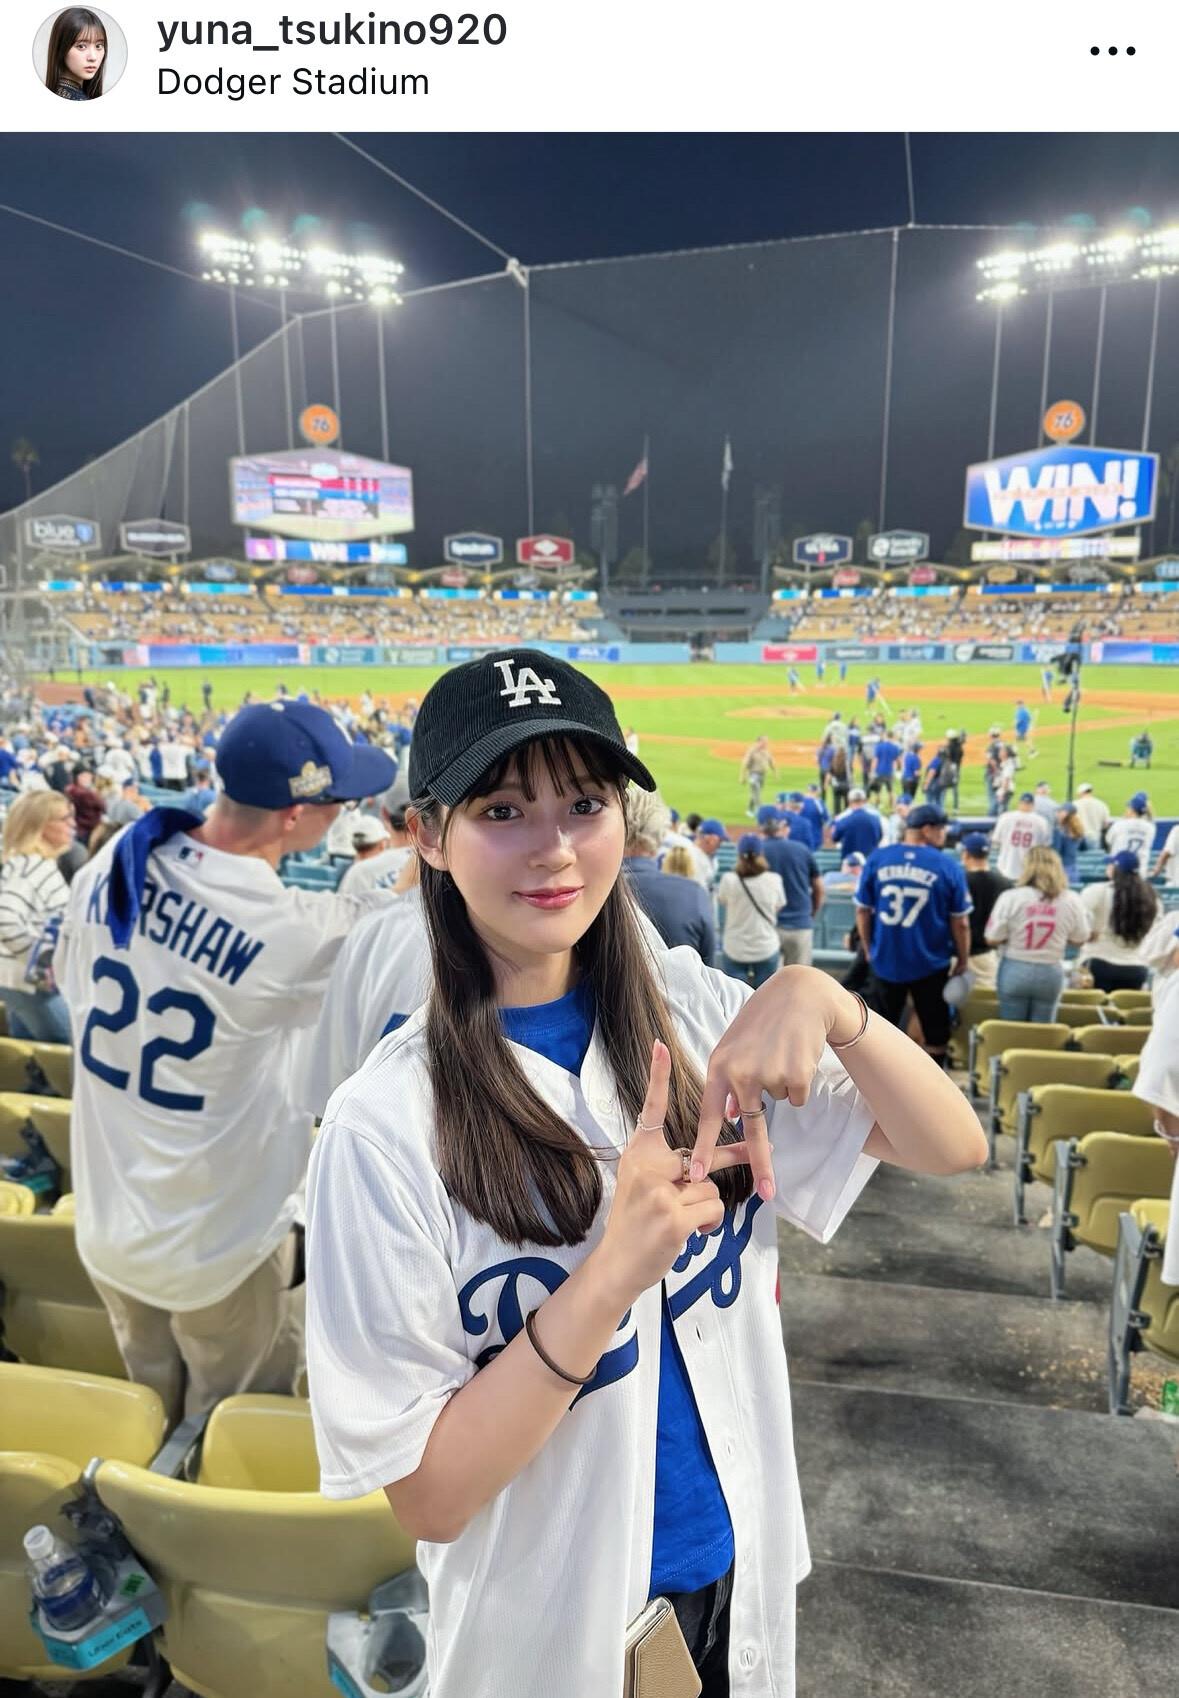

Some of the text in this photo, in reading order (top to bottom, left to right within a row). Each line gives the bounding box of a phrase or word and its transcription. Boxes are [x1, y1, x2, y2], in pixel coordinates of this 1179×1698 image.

[1055, 413, 1073, 429] 76
[983, 458, 1140, 526] WIN!
[33, 520, 75, 540] blue
[493, 658, 562, 708] LA
[86, 871, 265, 986] KRSHAW
[879, 885, 931, 928] 37
[1024, 920, 1057, 950] 17
[81, 955, 216, 1112] 22
